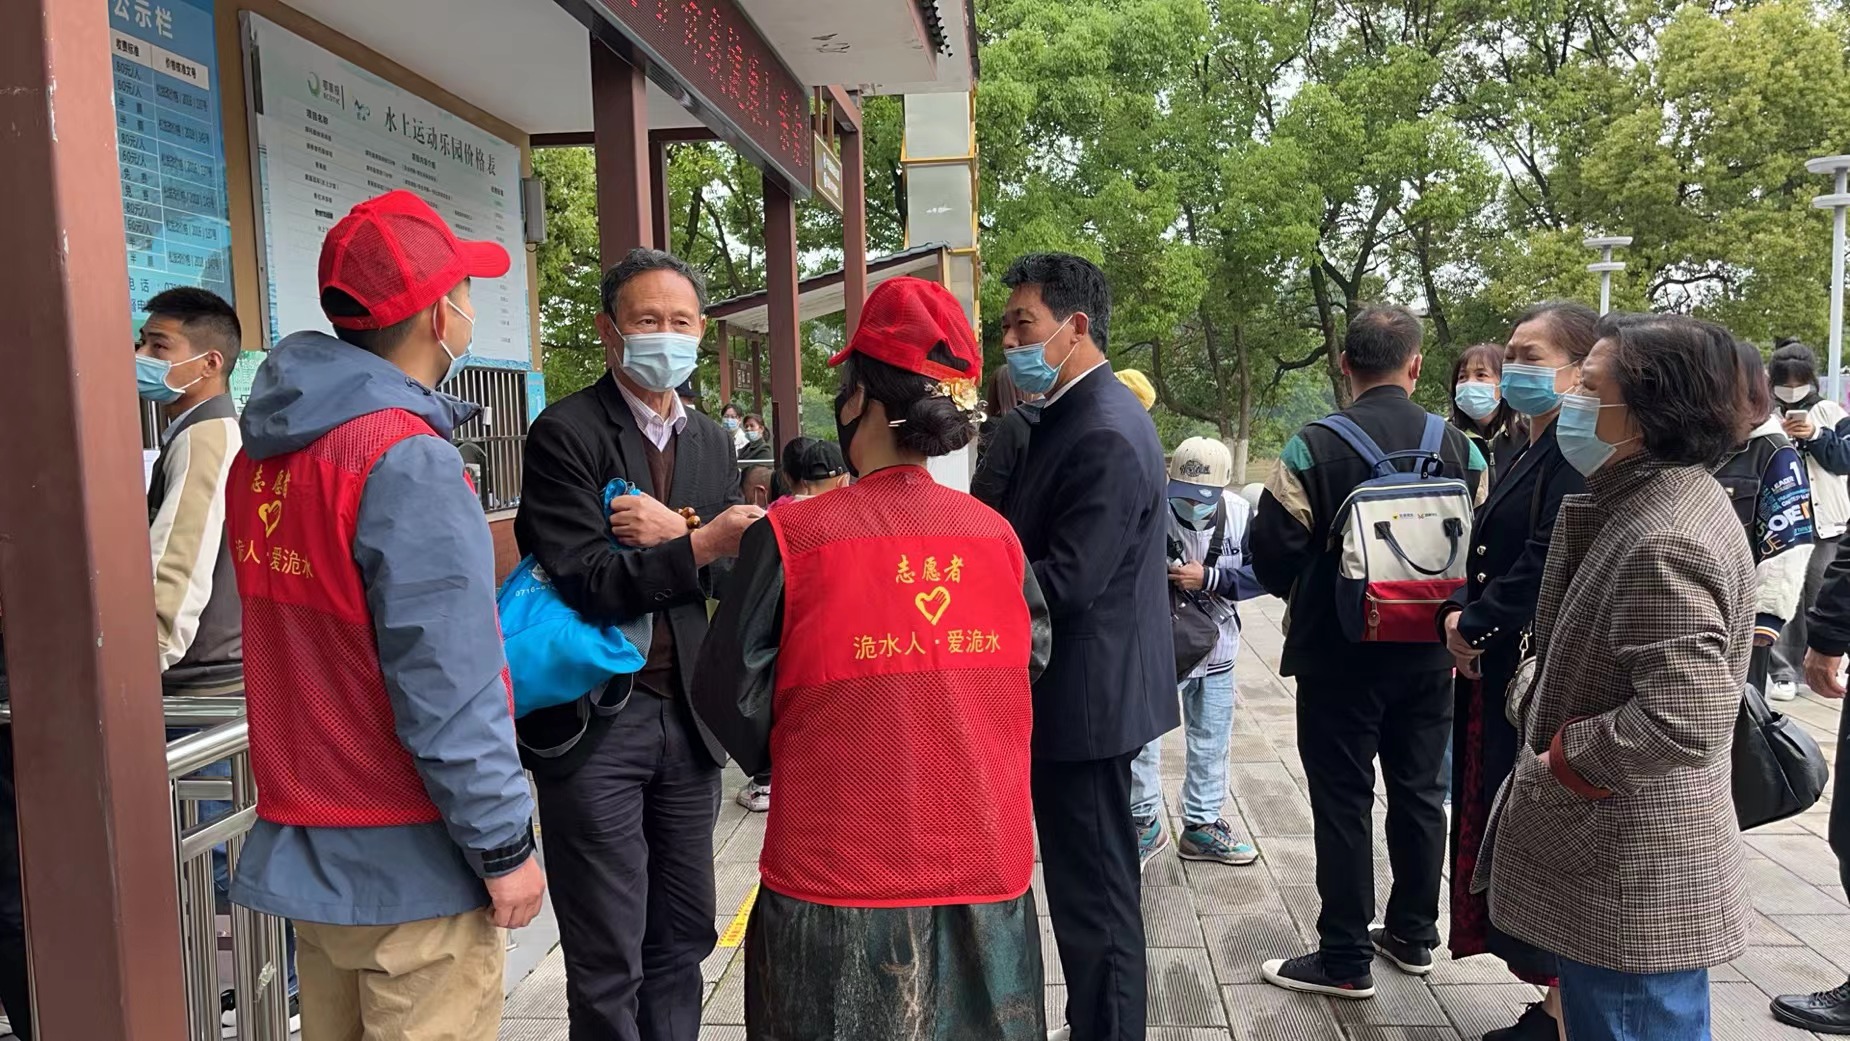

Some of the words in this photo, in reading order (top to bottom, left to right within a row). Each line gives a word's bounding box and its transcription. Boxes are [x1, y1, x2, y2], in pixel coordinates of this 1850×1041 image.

[114, 0, 173, 39] 公示栏
[384, 106, 496, 176] 水上运动乐园价格表
[1790, 461, 1803, 486] 1
[895, 554, 964, 584] 志愿者
